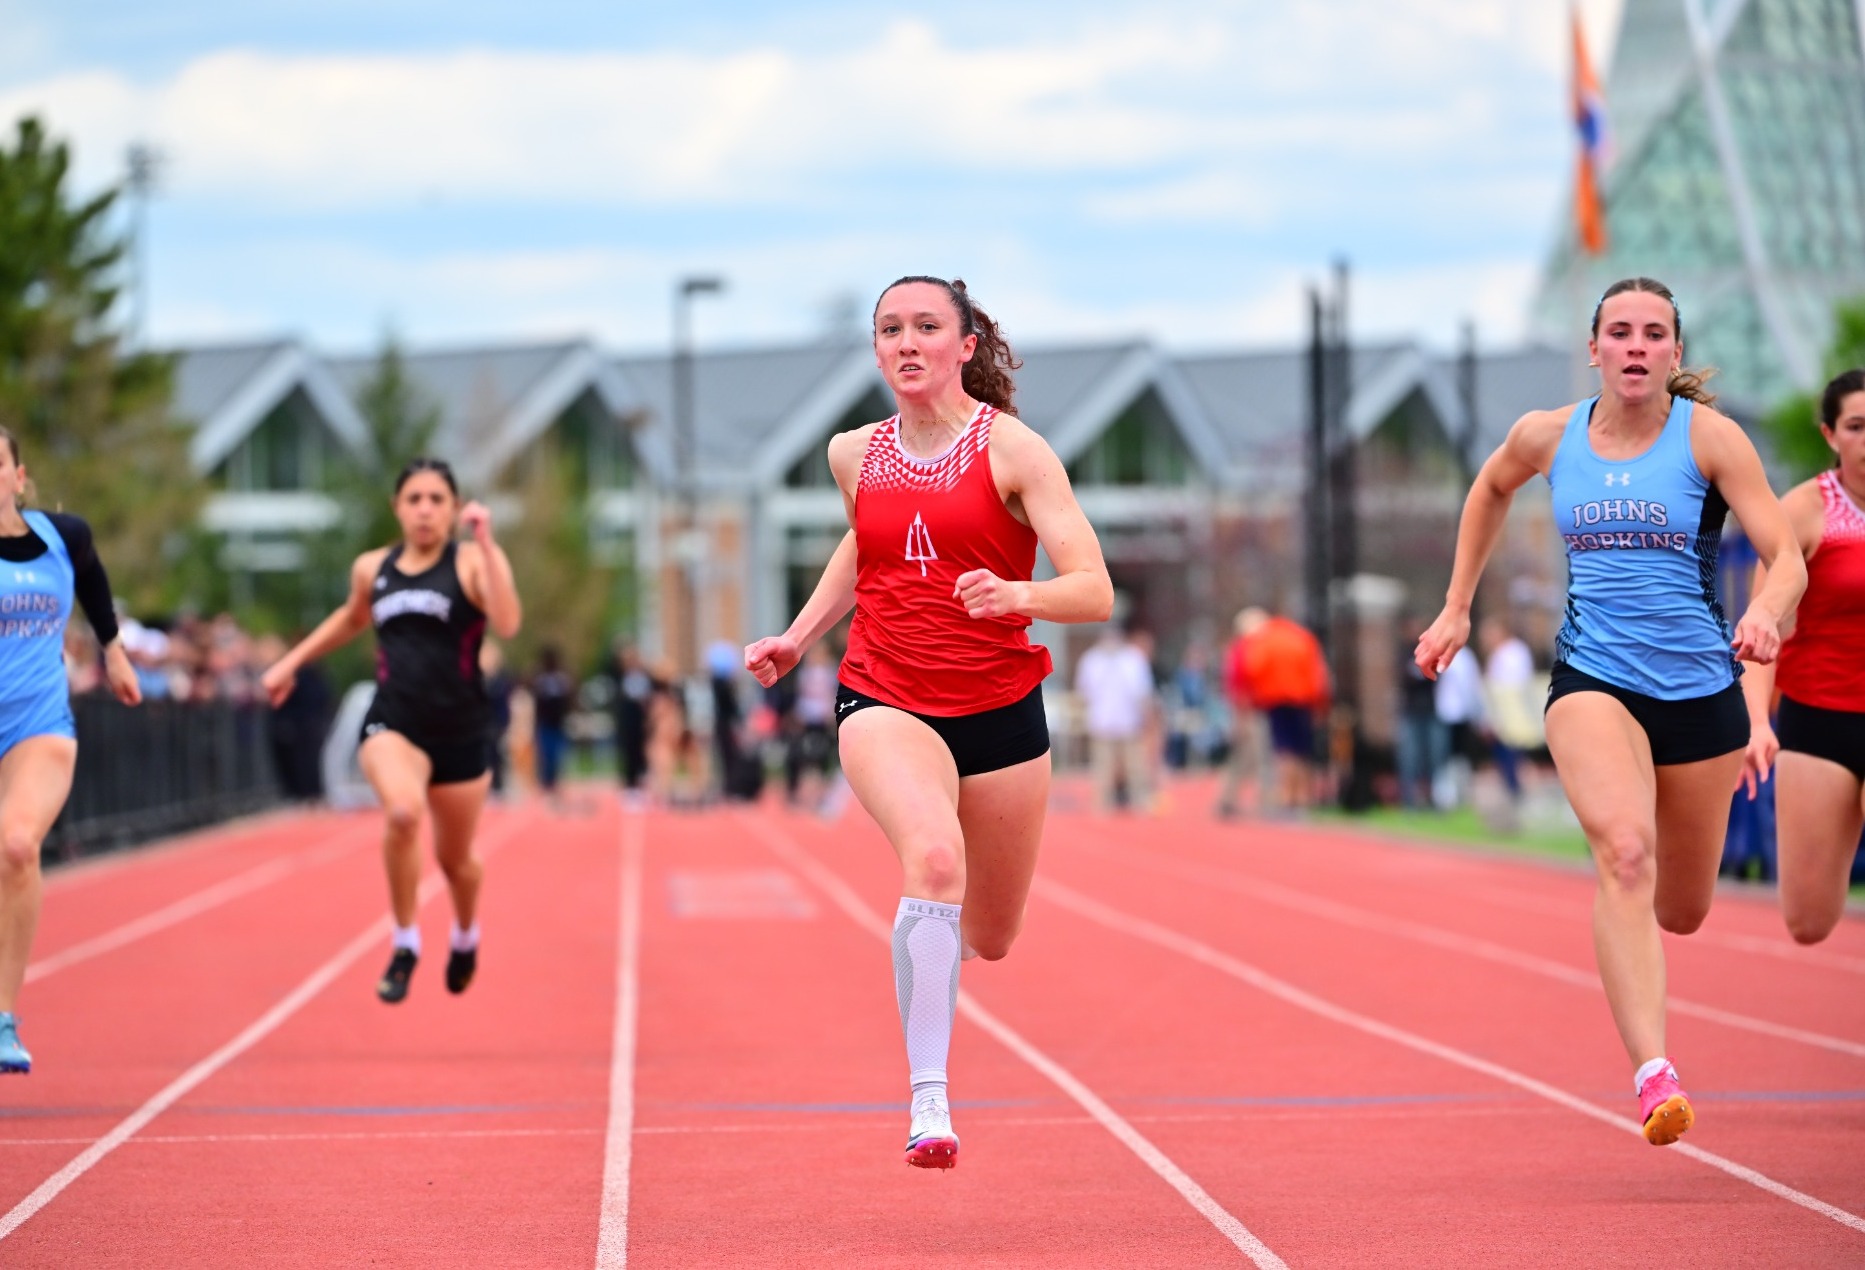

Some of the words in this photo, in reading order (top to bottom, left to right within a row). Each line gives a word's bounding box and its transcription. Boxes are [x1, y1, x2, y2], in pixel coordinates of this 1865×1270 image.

[1572, 499, 1669, 528] JOHNS
[1564, 532, 1688, 551] HOPKINS
[0, 591, 60, 615] OHNS
